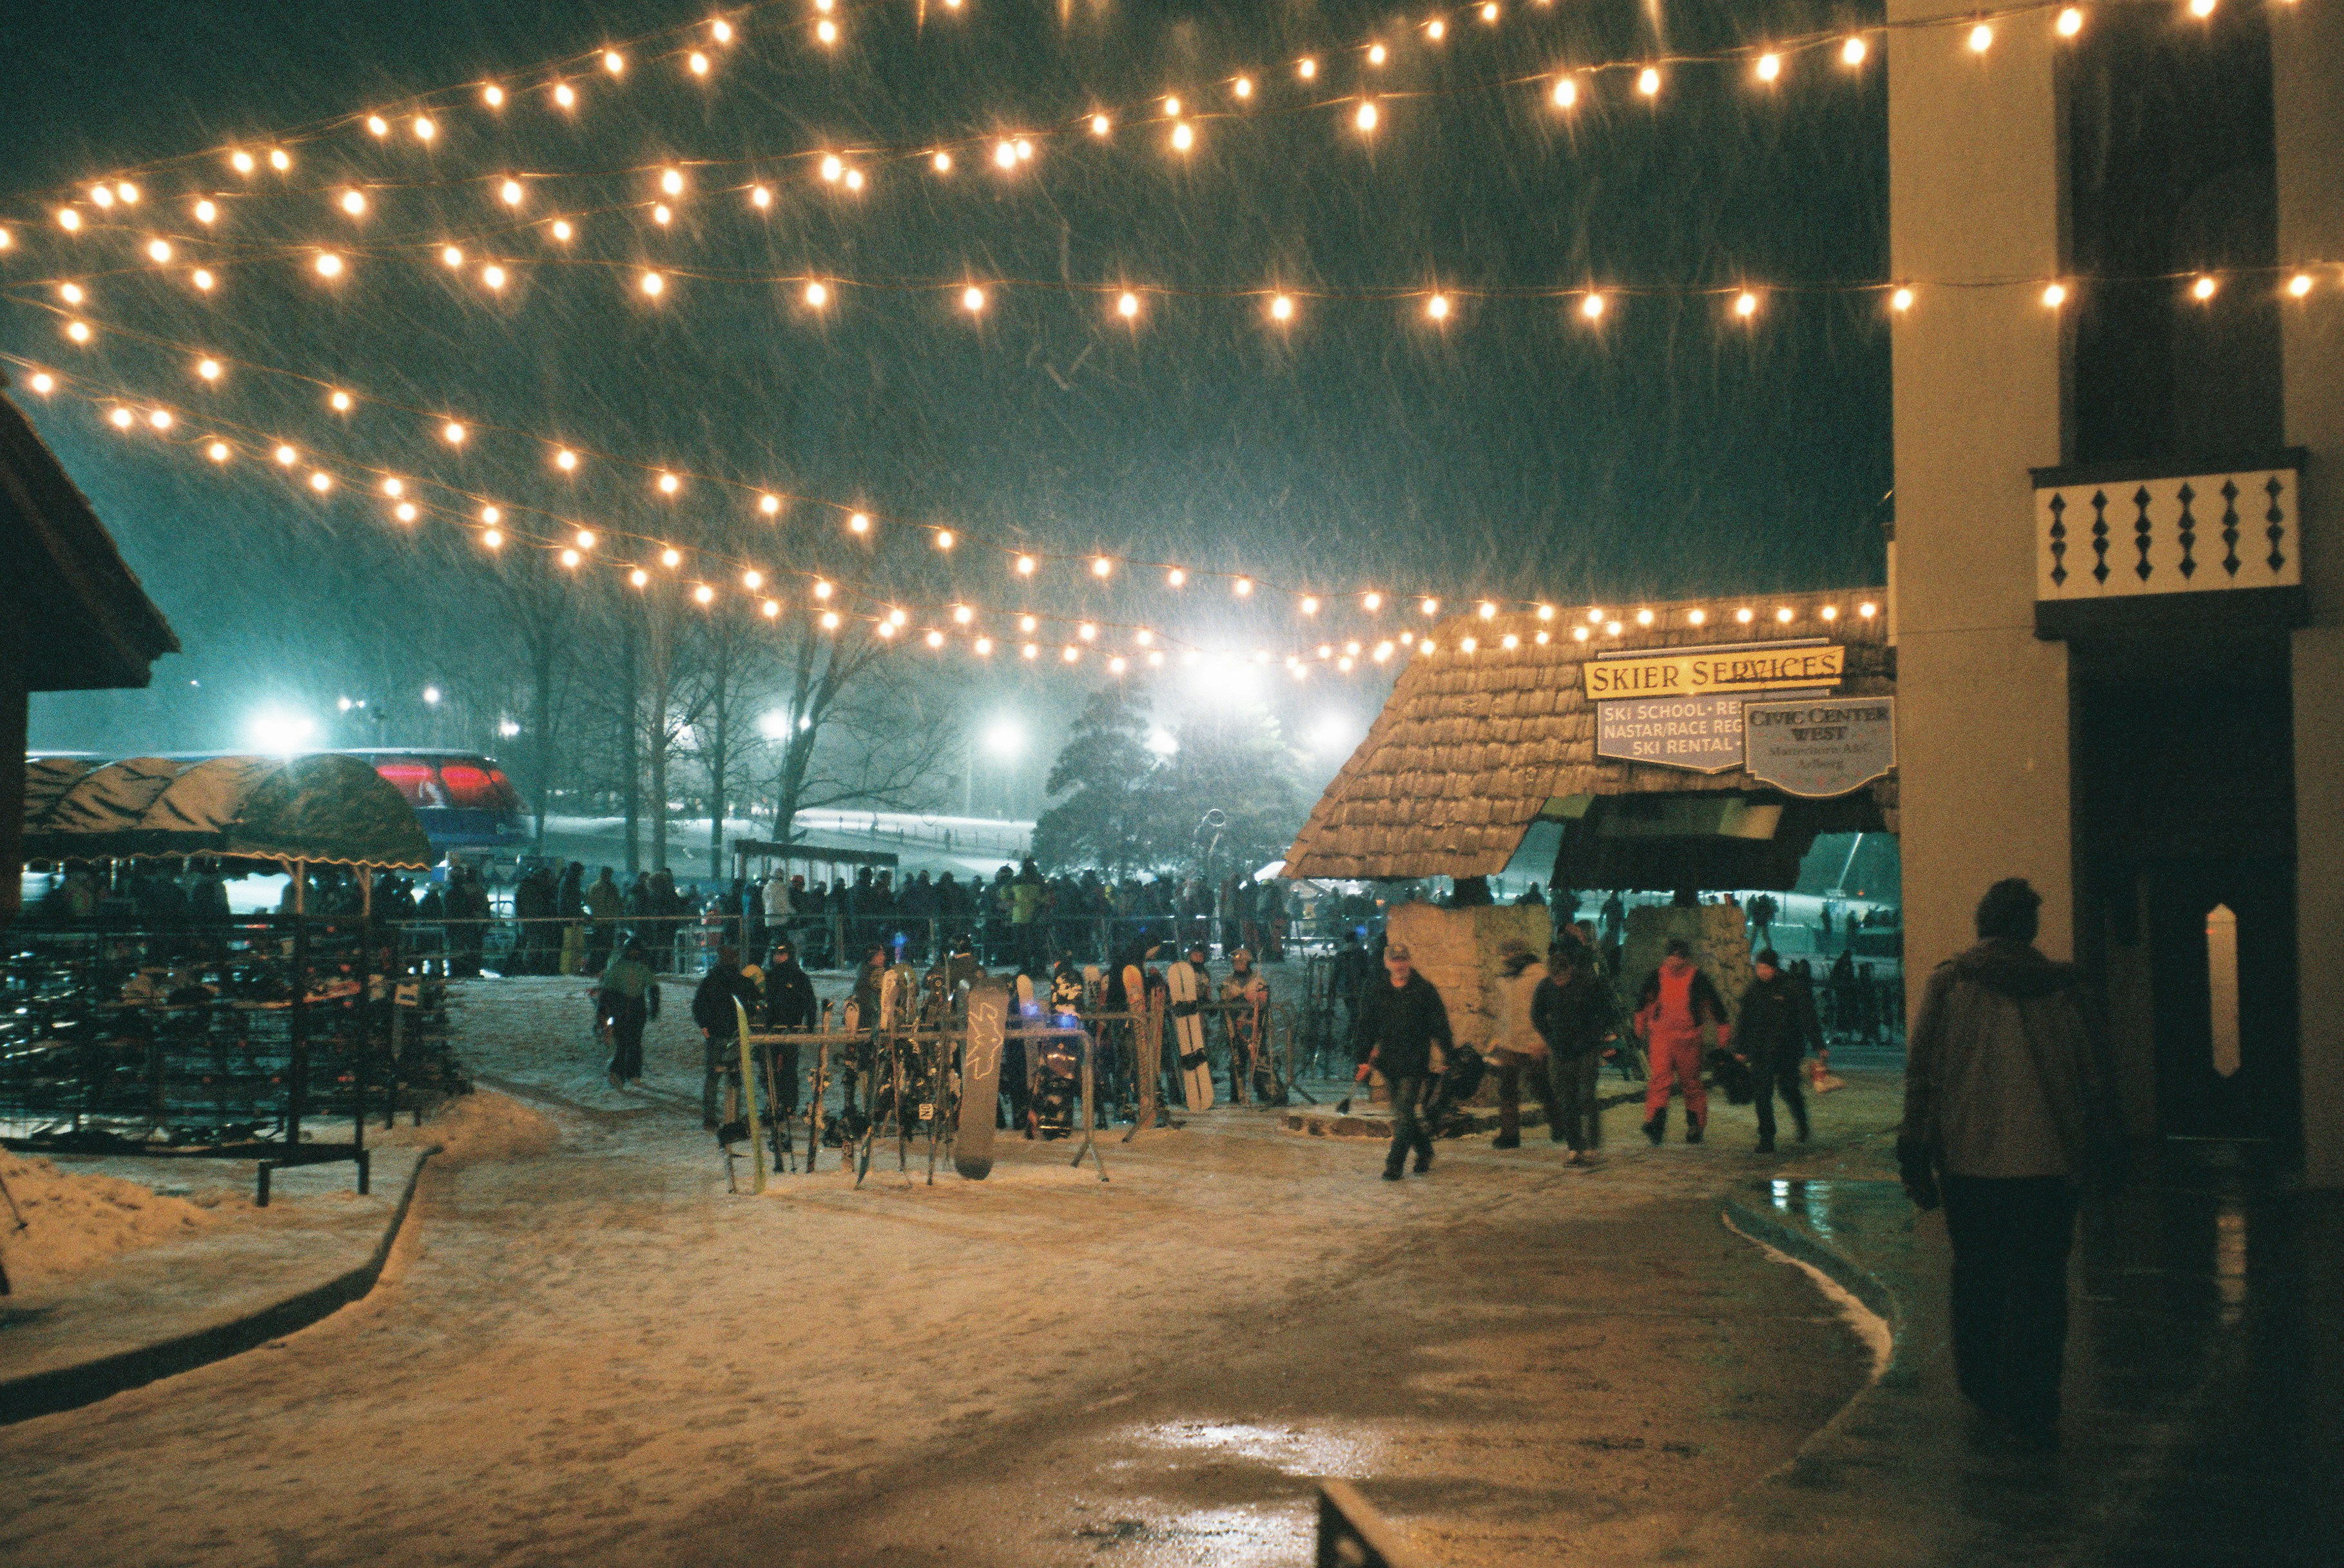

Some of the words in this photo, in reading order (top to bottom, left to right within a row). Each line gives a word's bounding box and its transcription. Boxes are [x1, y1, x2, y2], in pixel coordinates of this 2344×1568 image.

[1592, 665, 1679, 692] SKIER
[1690, 654, 1837, 685] SERVICES
[1605, 707, 1631, 721] SKI
[1638, 703, 1707, 720] SCHOOL
[1749, 710, 1805, 725] CIVIC
[1808, 707, 1890, 723] CENTER
[1604, 721, 1707, 739] NASTAR/RACE
[1791, 726, 1848, 741] WEST
[1632, 740, 1660, 756] SKI
[1667, 738, 1734, 753] RENTAL
